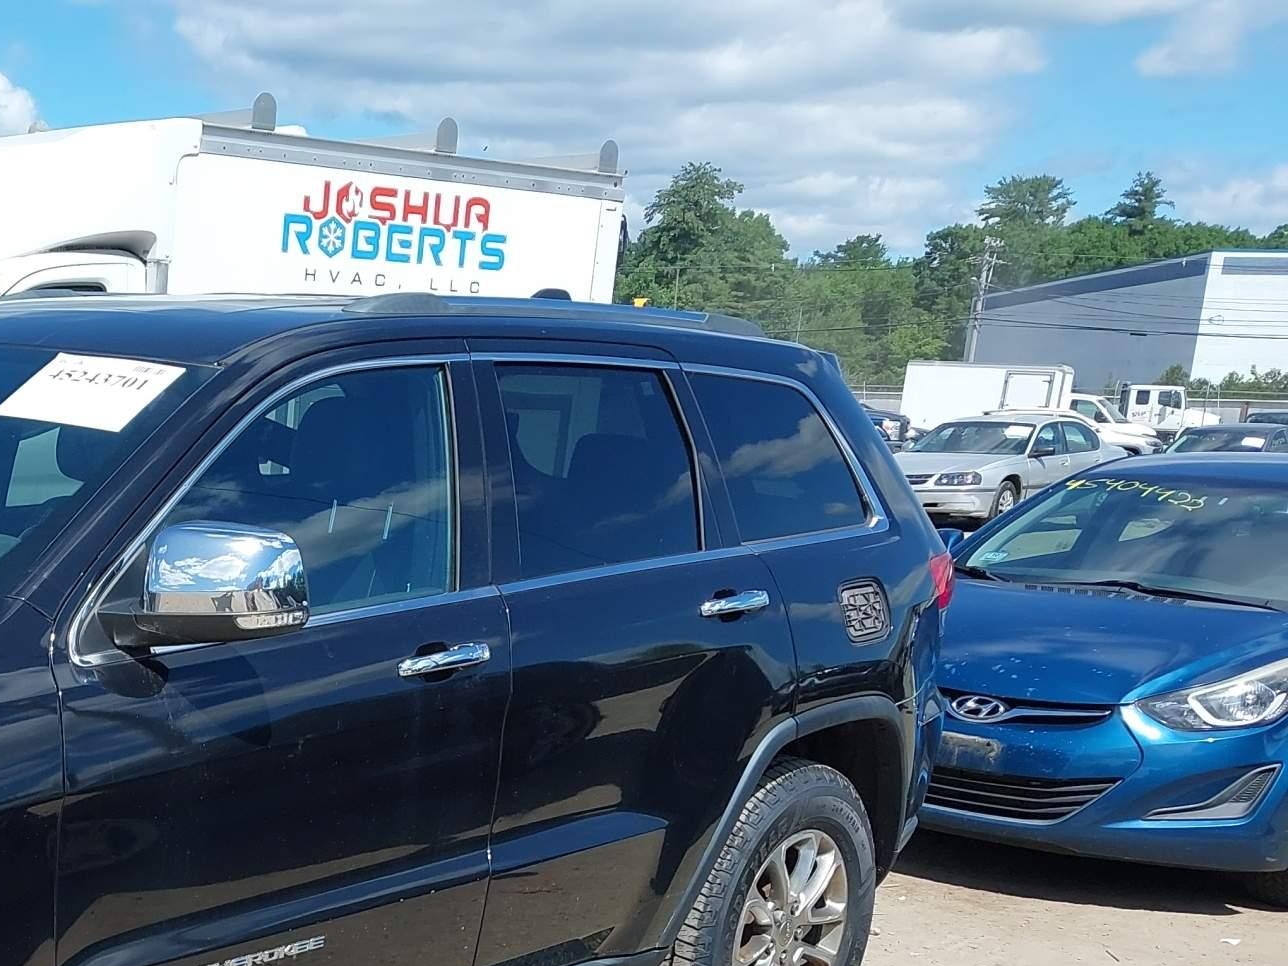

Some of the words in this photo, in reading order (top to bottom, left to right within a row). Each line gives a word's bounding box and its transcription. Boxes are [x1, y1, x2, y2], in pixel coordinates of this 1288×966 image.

[303, 180, 491, 232] JOSHUA
[281, 213, 507, 271] ROBERTS
[304, 268, 402, 289] HVAC,
[429, 277, 481, 294] LLC
[49, 369, 149, 391] 45243701
